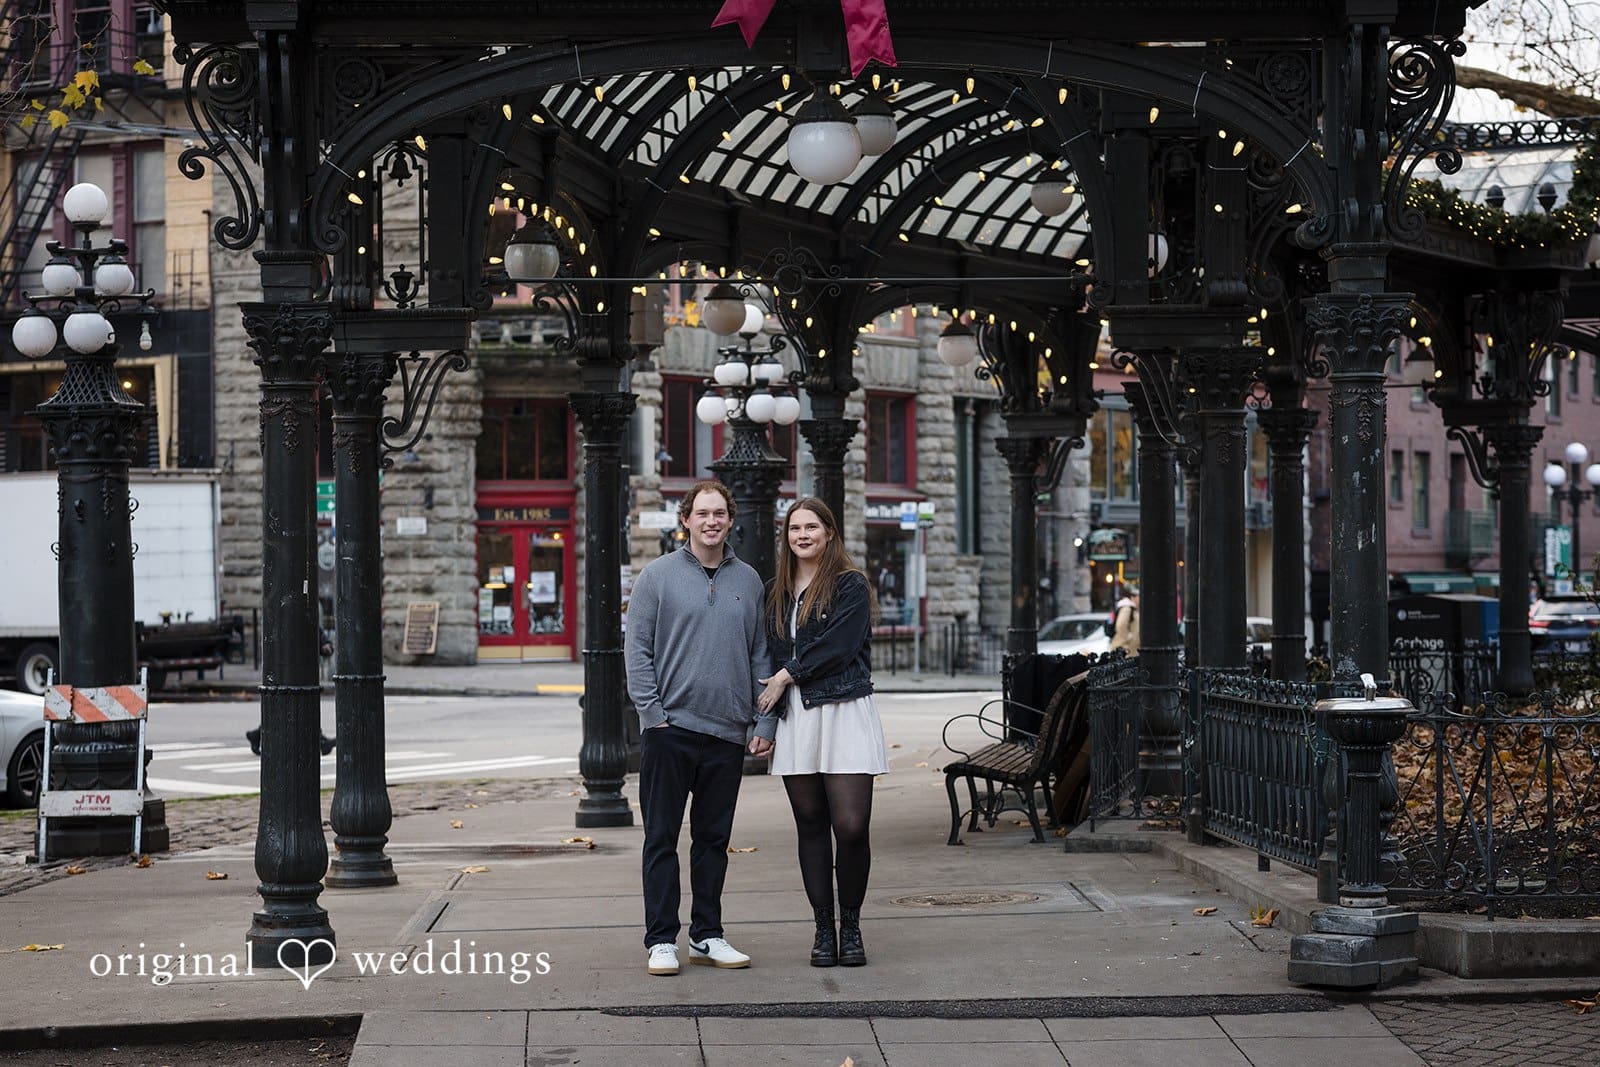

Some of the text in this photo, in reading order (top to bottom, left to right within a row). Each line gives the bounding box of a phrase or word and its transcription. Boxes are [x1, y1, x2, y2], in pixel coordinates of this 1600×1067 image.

[495, 508, 551, 520] Est. 1985
[76, 794, 110, 804] JTM
